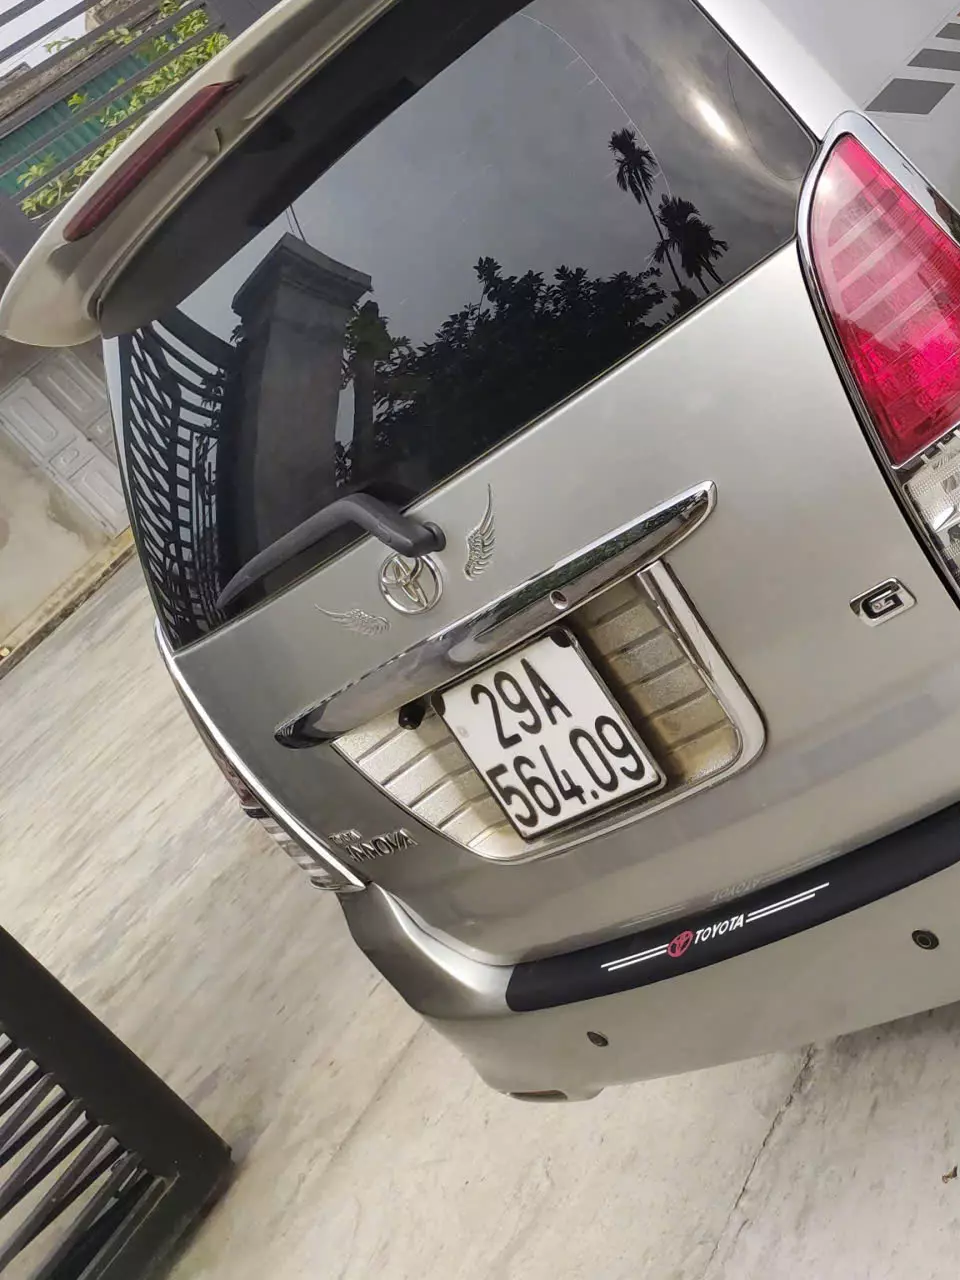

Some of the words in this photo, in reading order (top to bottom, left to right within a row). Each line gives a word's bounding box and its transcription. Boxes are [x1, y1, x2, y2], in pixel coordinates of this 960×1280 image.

[470, 657, 573, 750] 29A
[485, 715, 646, 829] 564.09
[693, 913, 745, 945] TOYOTA
